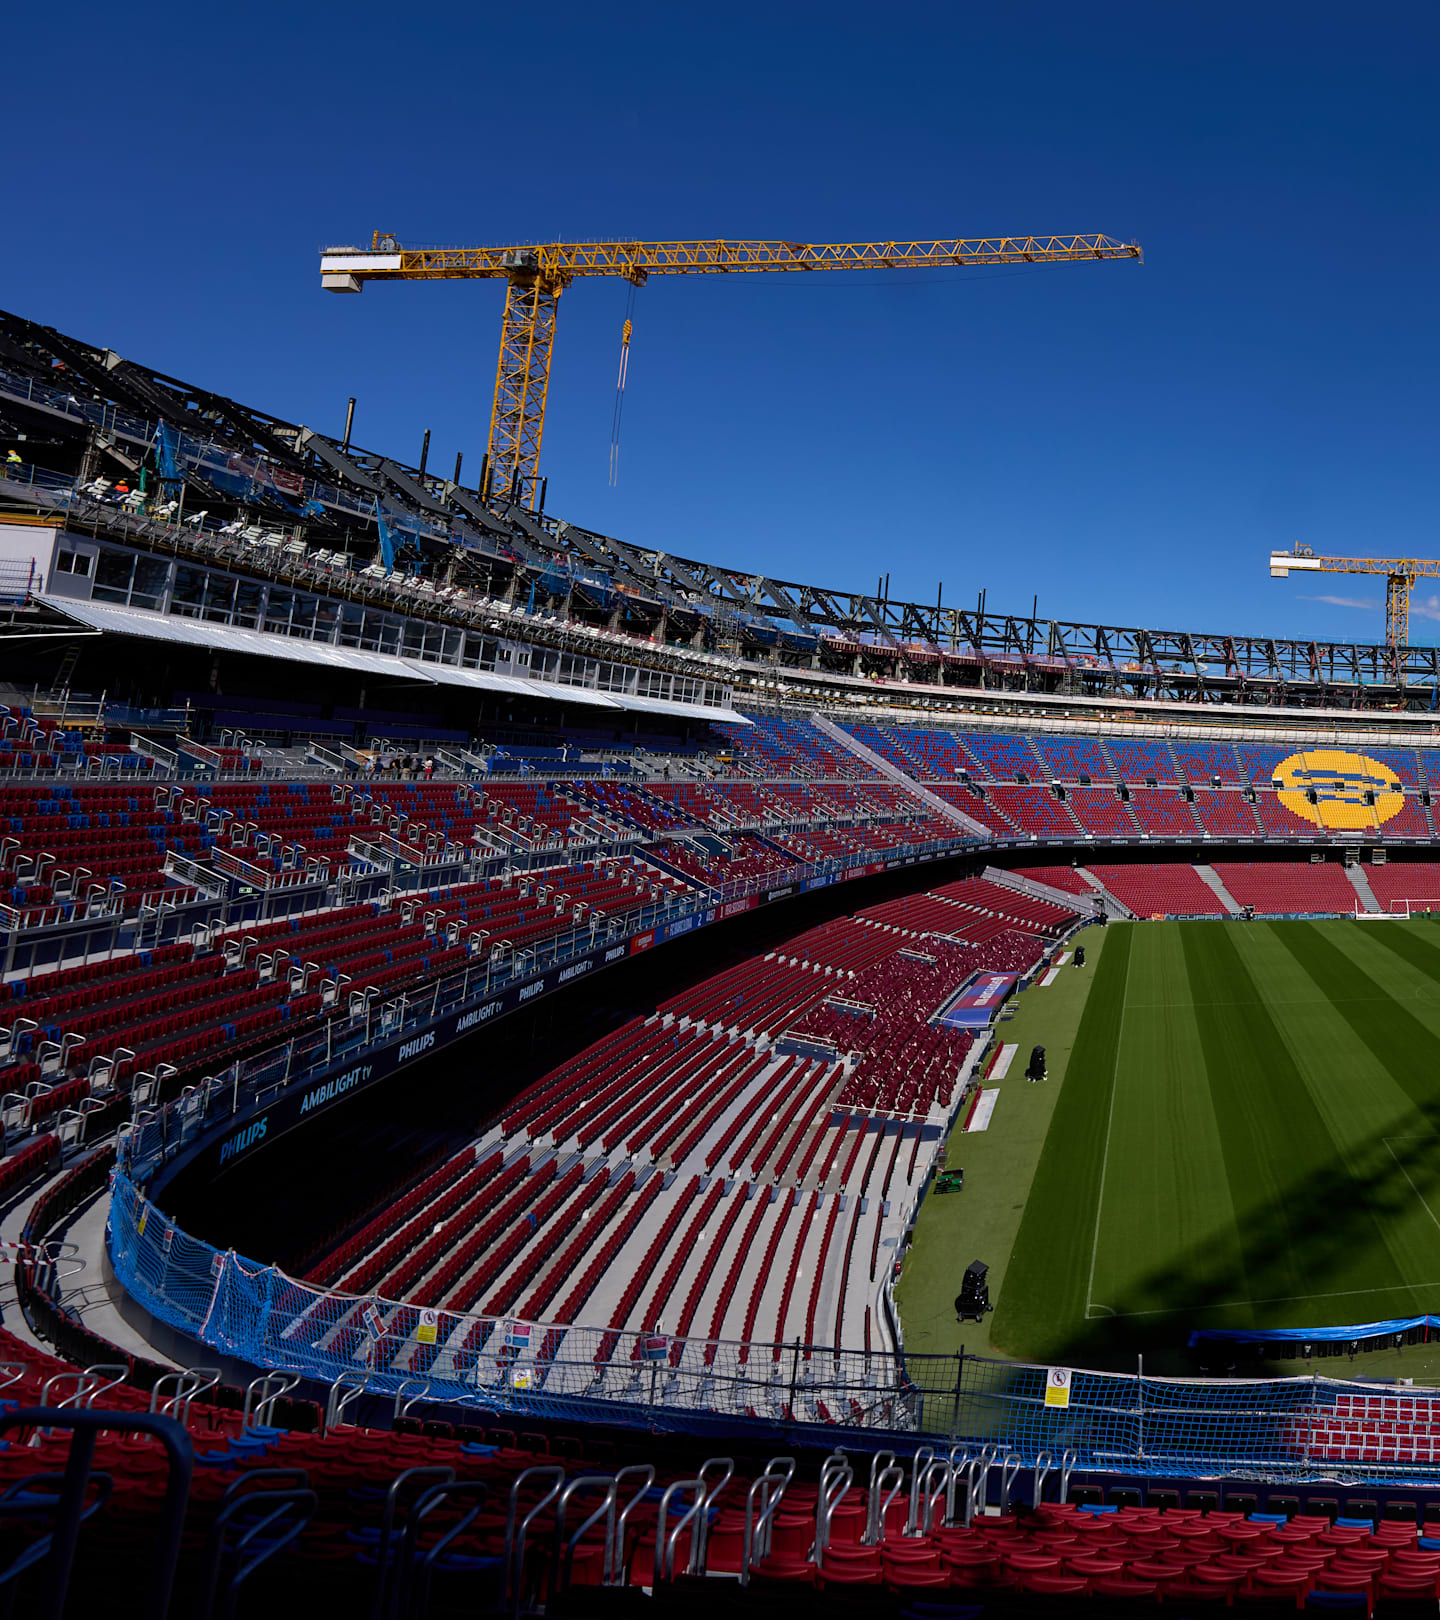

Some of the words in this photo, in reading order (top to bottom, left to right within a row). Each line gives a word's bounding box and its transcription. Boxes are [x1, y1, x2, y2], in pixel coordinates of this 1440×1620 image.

[697, 913, 702, 926] 2
[605, 945, 625, 963] PHILIPS
[558, 960, 587, 984] AMBILIGHT
[519, 979, 544, 1002] PHILIPS
[456, 1002, 494, 1034] AMBILIGHT
[495, 1001, 503, 1013] tv
[398, 1031, 436, 1063] PHILIPS
[300, 1067, 360, 1115] AMBILIGHT
[362, 1065, 372, 1081] tv
[219, 1117, 268, 1166] PHILIPS
